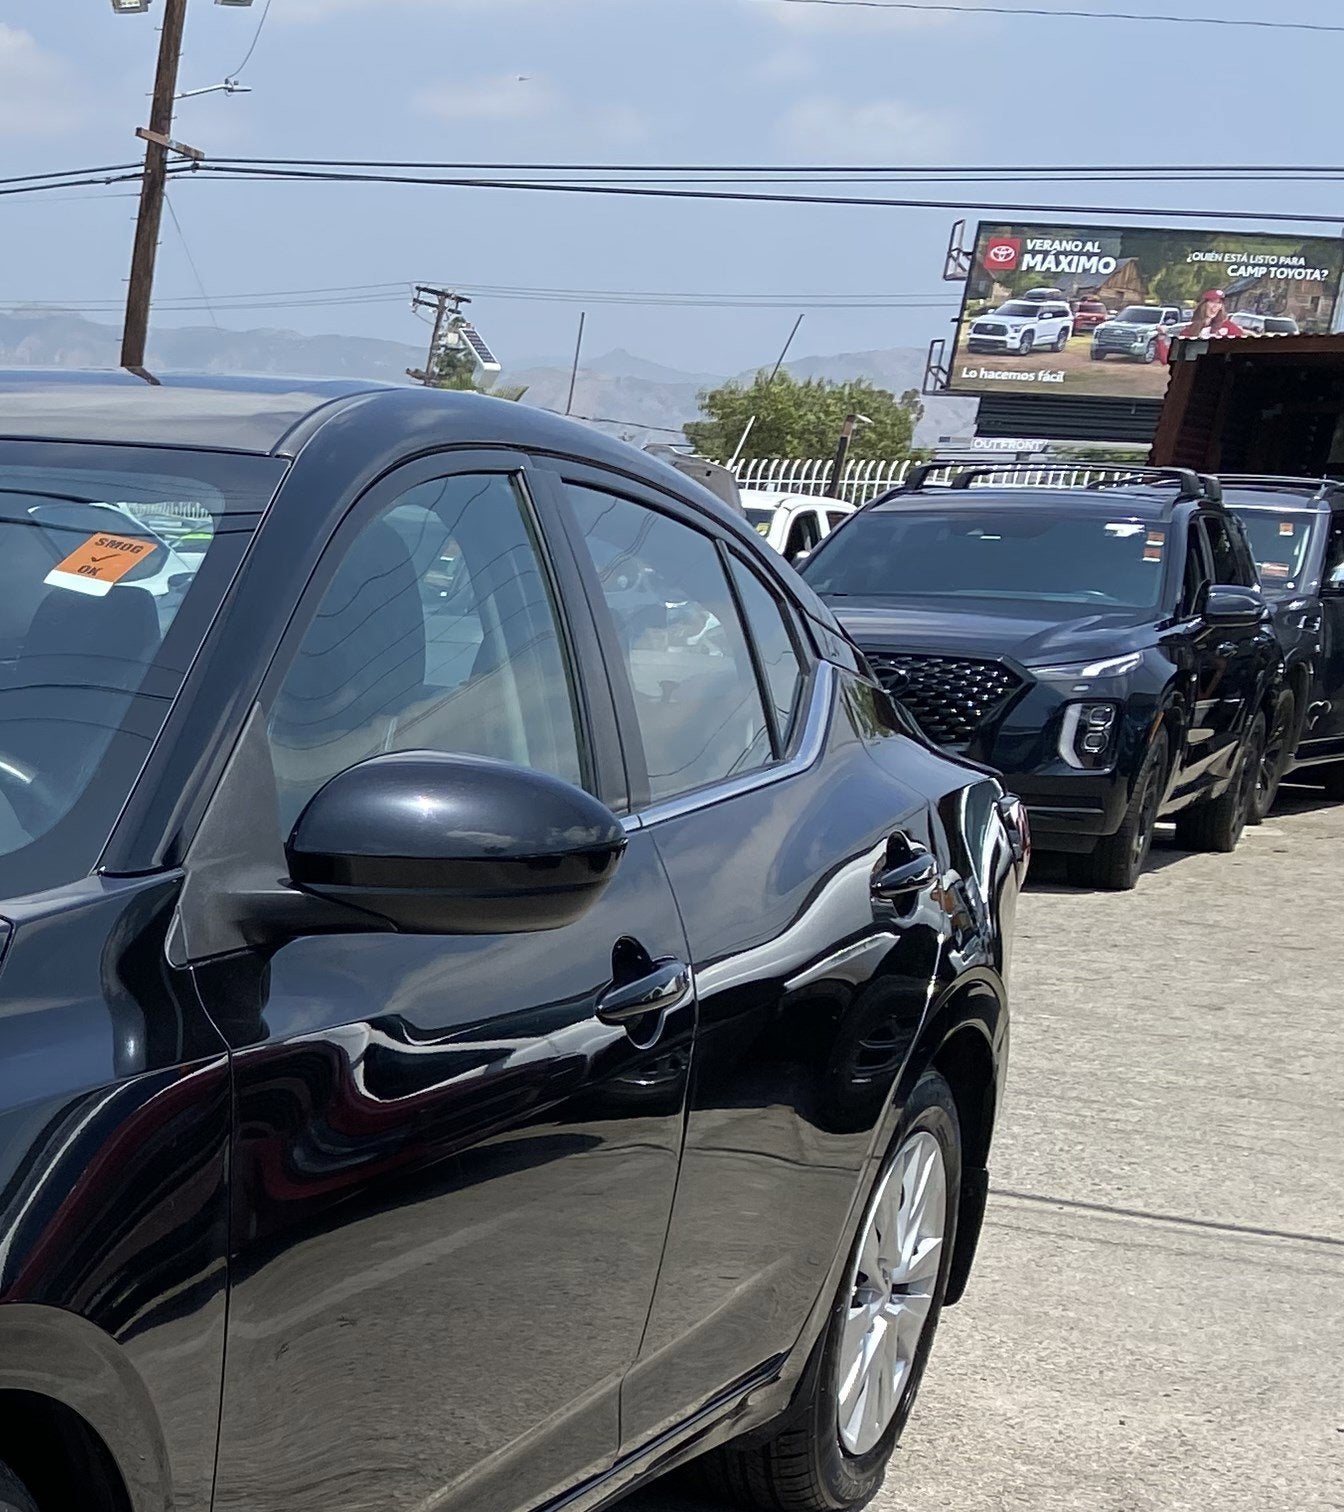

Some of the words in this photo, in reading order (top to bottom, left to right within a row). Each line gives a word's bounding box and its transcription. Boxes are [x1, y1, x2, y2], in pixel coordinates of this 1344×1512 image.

[1026, 239, 1082, 252] VERANO
[1083, 241, 1102, 253] AL
[1021, 250, 1117, 275] MÁXIMO
[1223, 252, 1248, 263] ESTÁ
[1249, 255, 1276, 265] LISTO
[1278, 256, 1305, 266] PARA
[1227, 265, 1268, 277] CAMP
[1269, 267, 1329, 281] TOYOTA?
[961, 367, 977, 379] Lo
[979, 367, 1036, 381] hacemos
[1037, 370, 1065, 383] fácil
[94, 537, 144, 554] SMOG
[78, 565, 104, 576] OK
